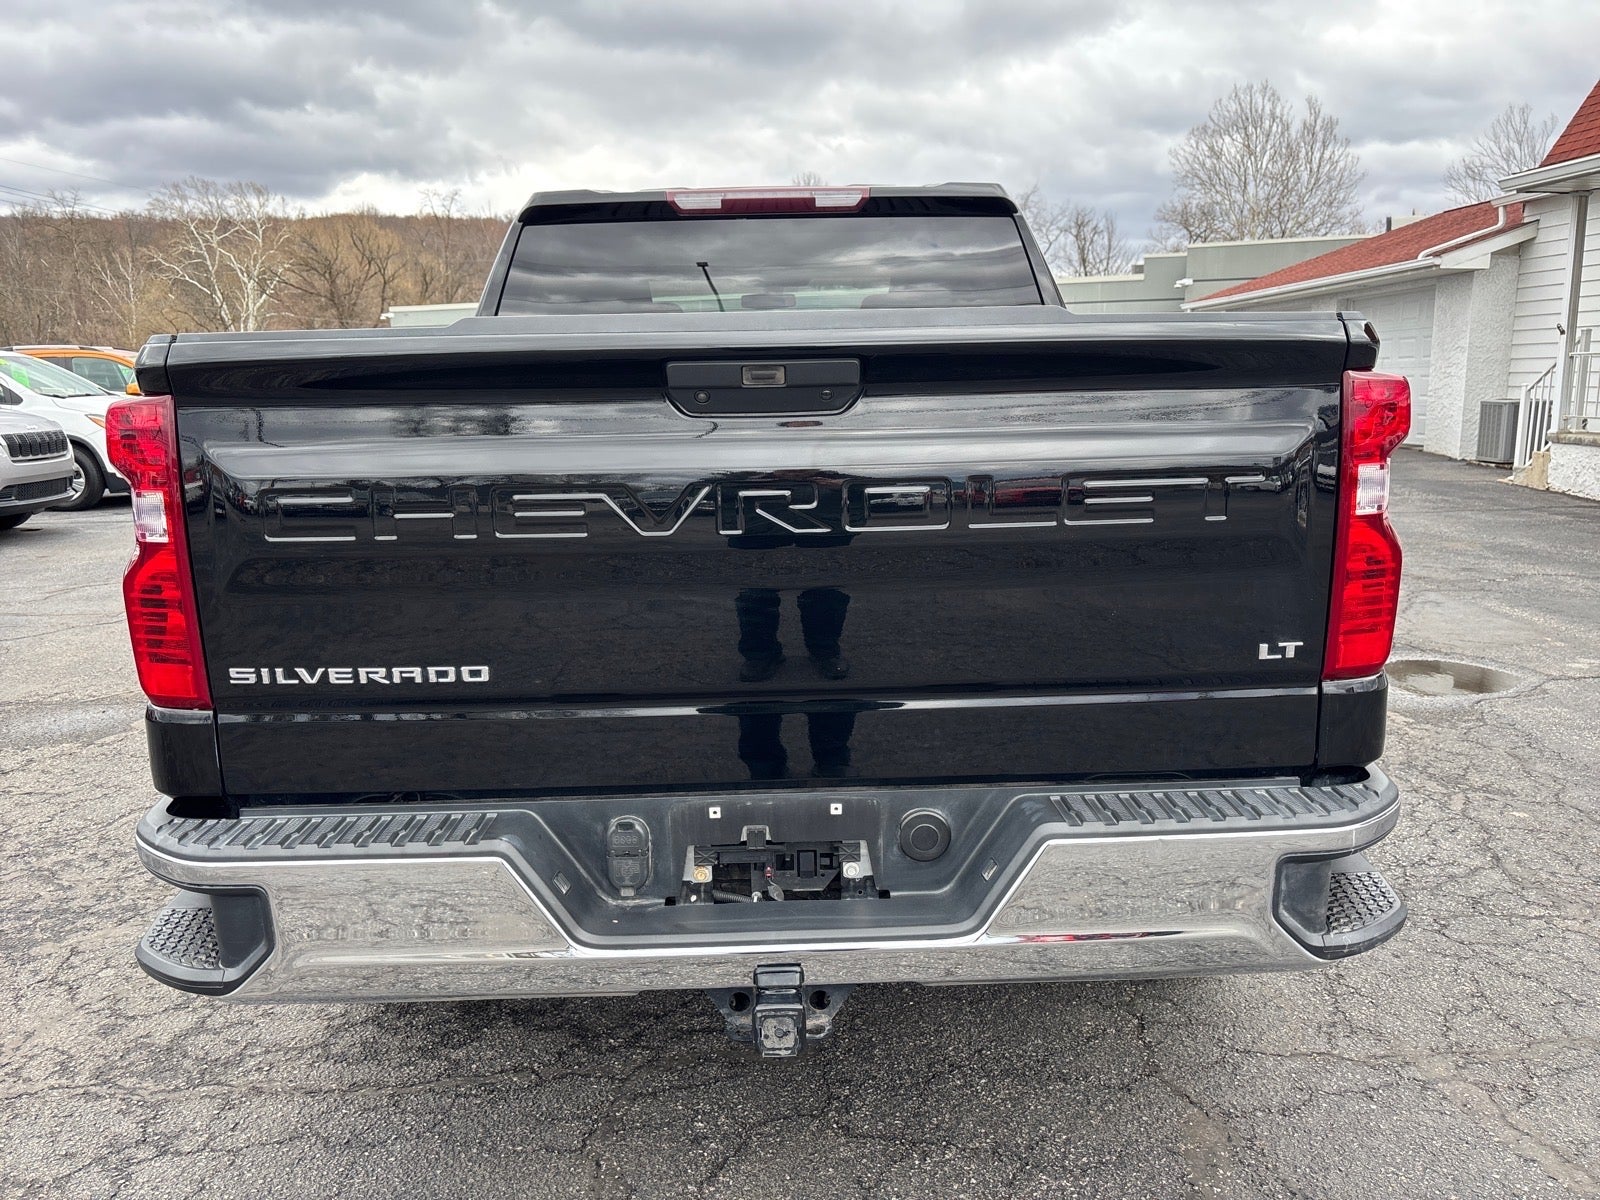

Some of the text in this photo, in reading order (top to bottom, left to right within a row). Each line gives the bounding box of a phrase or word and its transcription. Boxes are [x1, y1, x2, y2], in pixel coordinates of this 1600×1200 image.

[260, 470, 1267, 542] CHEVROLET
[1258, 641, 1304, 660] LT
[228, 665, 491, 686] SILVERADO
